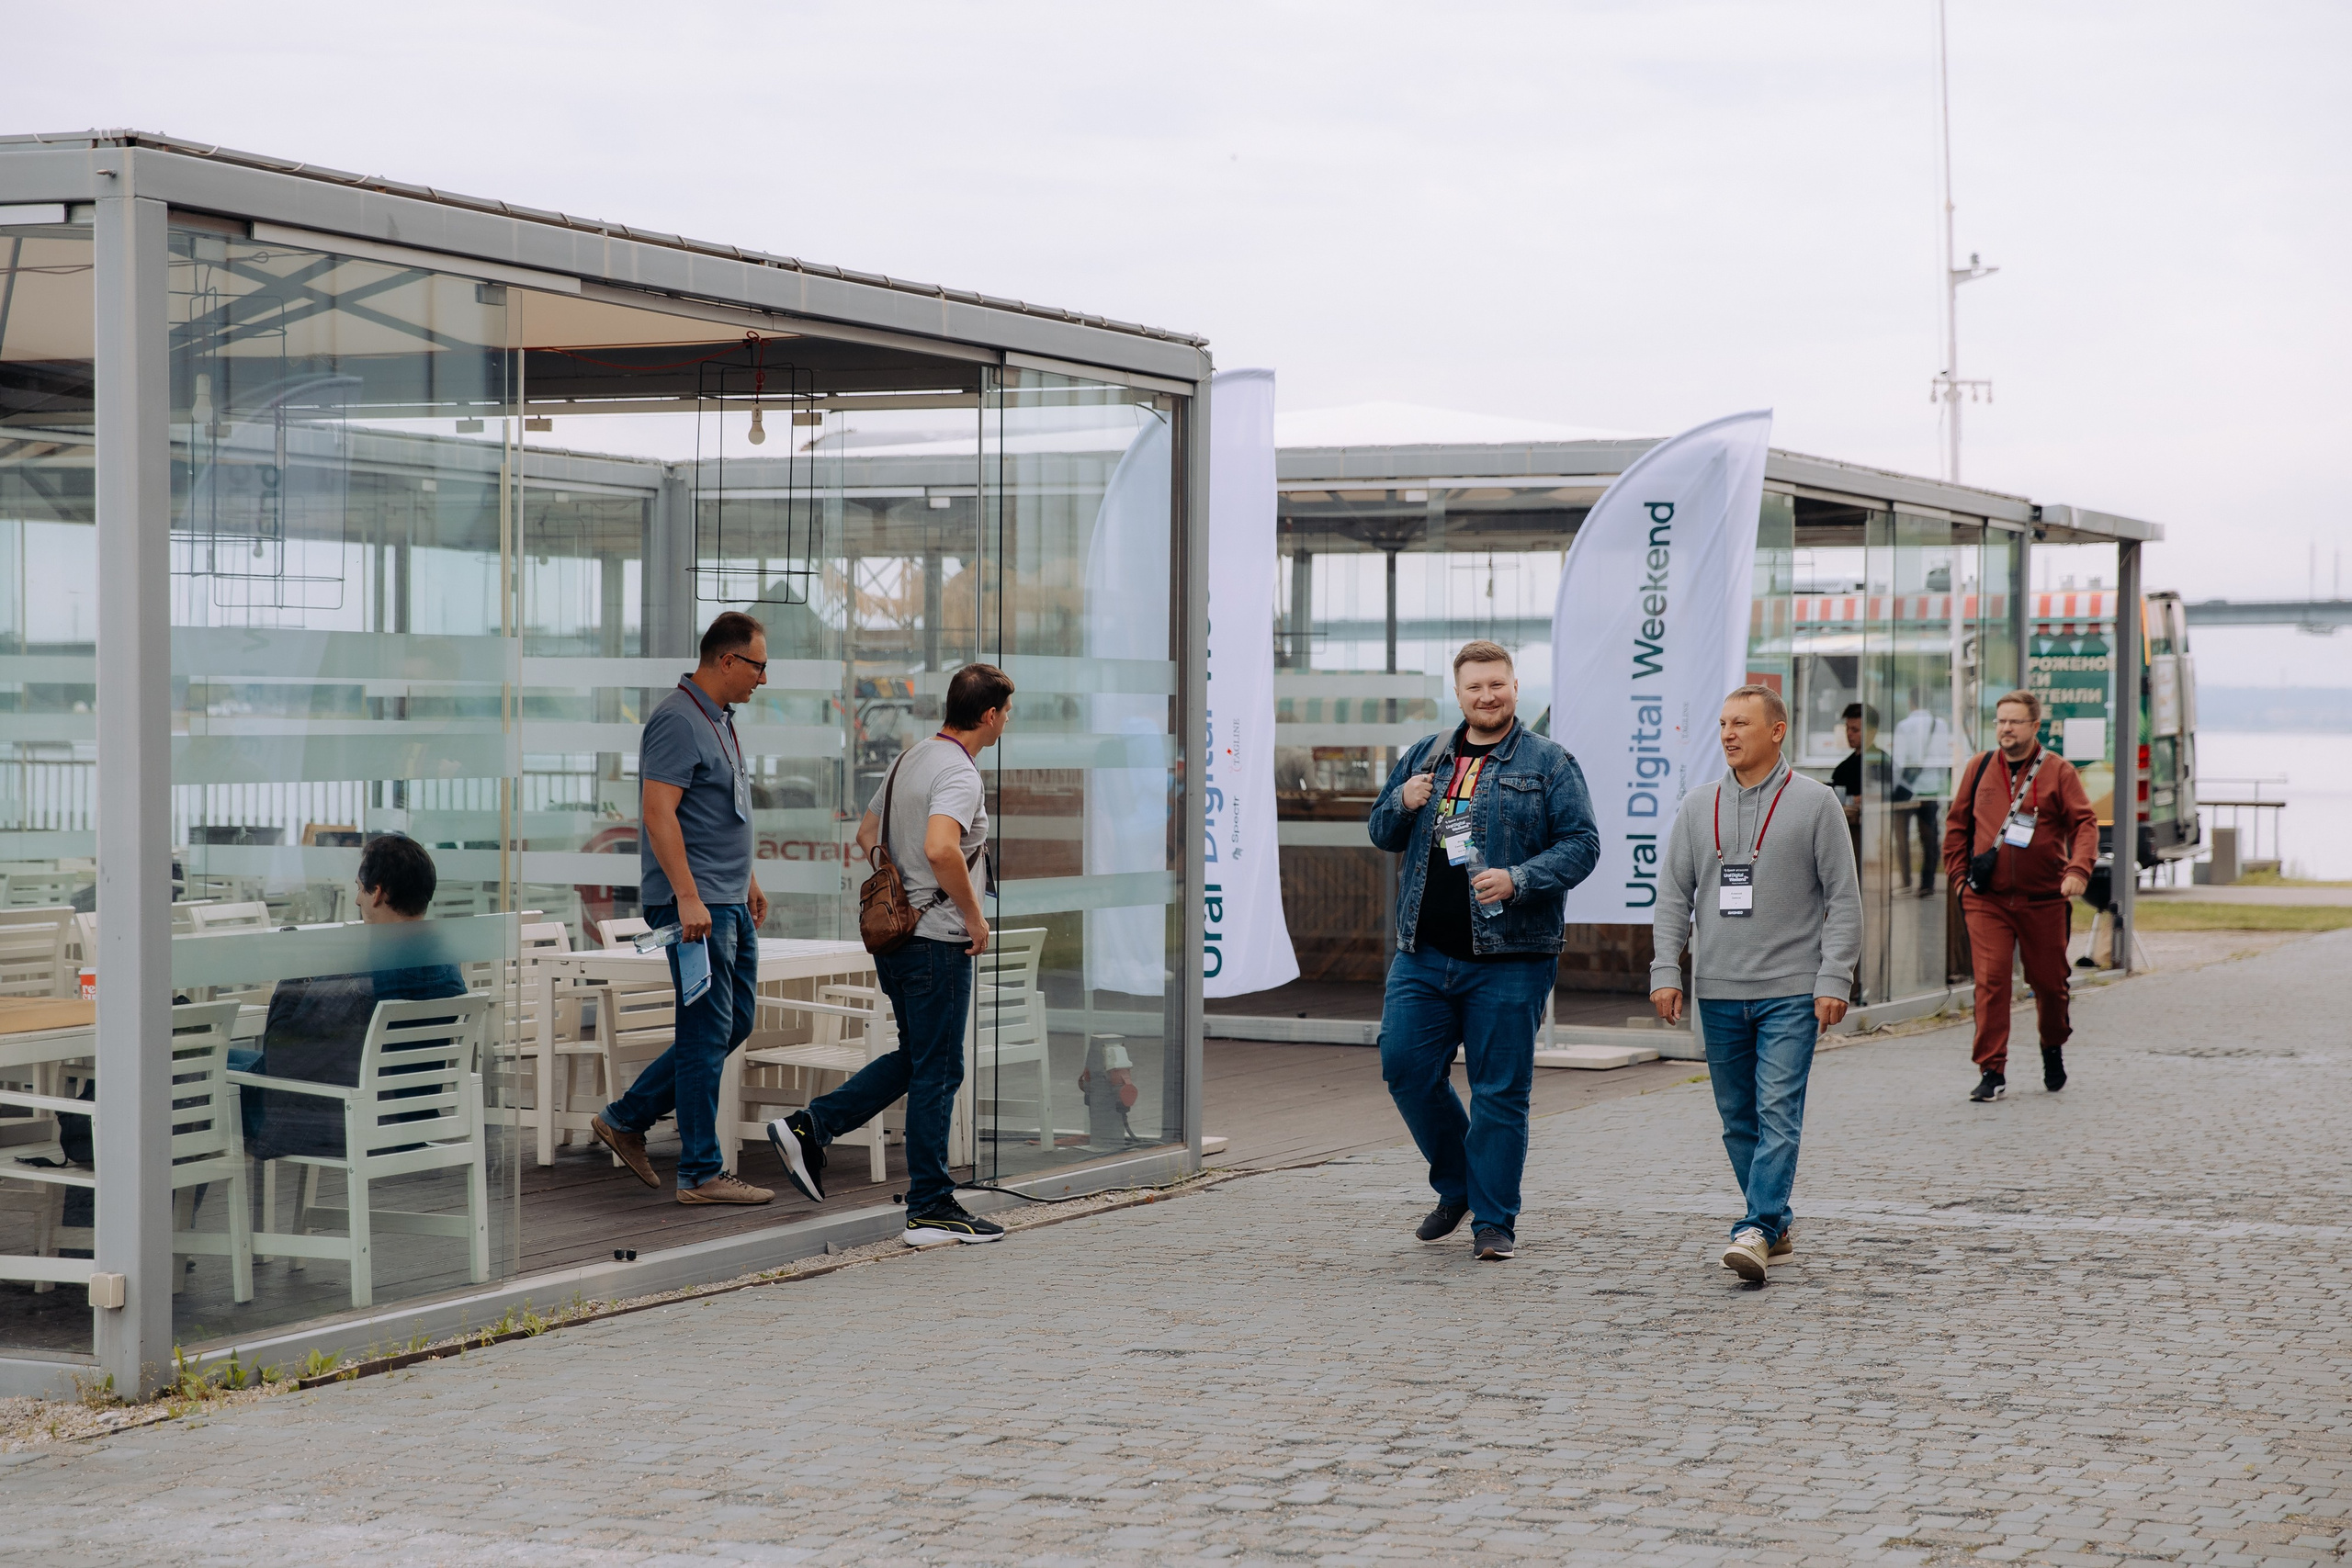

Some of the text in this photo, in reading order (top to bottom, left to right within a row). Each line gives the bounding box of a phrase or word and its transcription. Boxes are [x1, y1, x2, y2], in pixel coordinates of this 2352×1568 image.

[1625, 502, 1674, 908] Ural Digital Weekend
[1232, 719, 1240, 765] TAGLINE
[1231, 796, 1240, 843] Spectr
